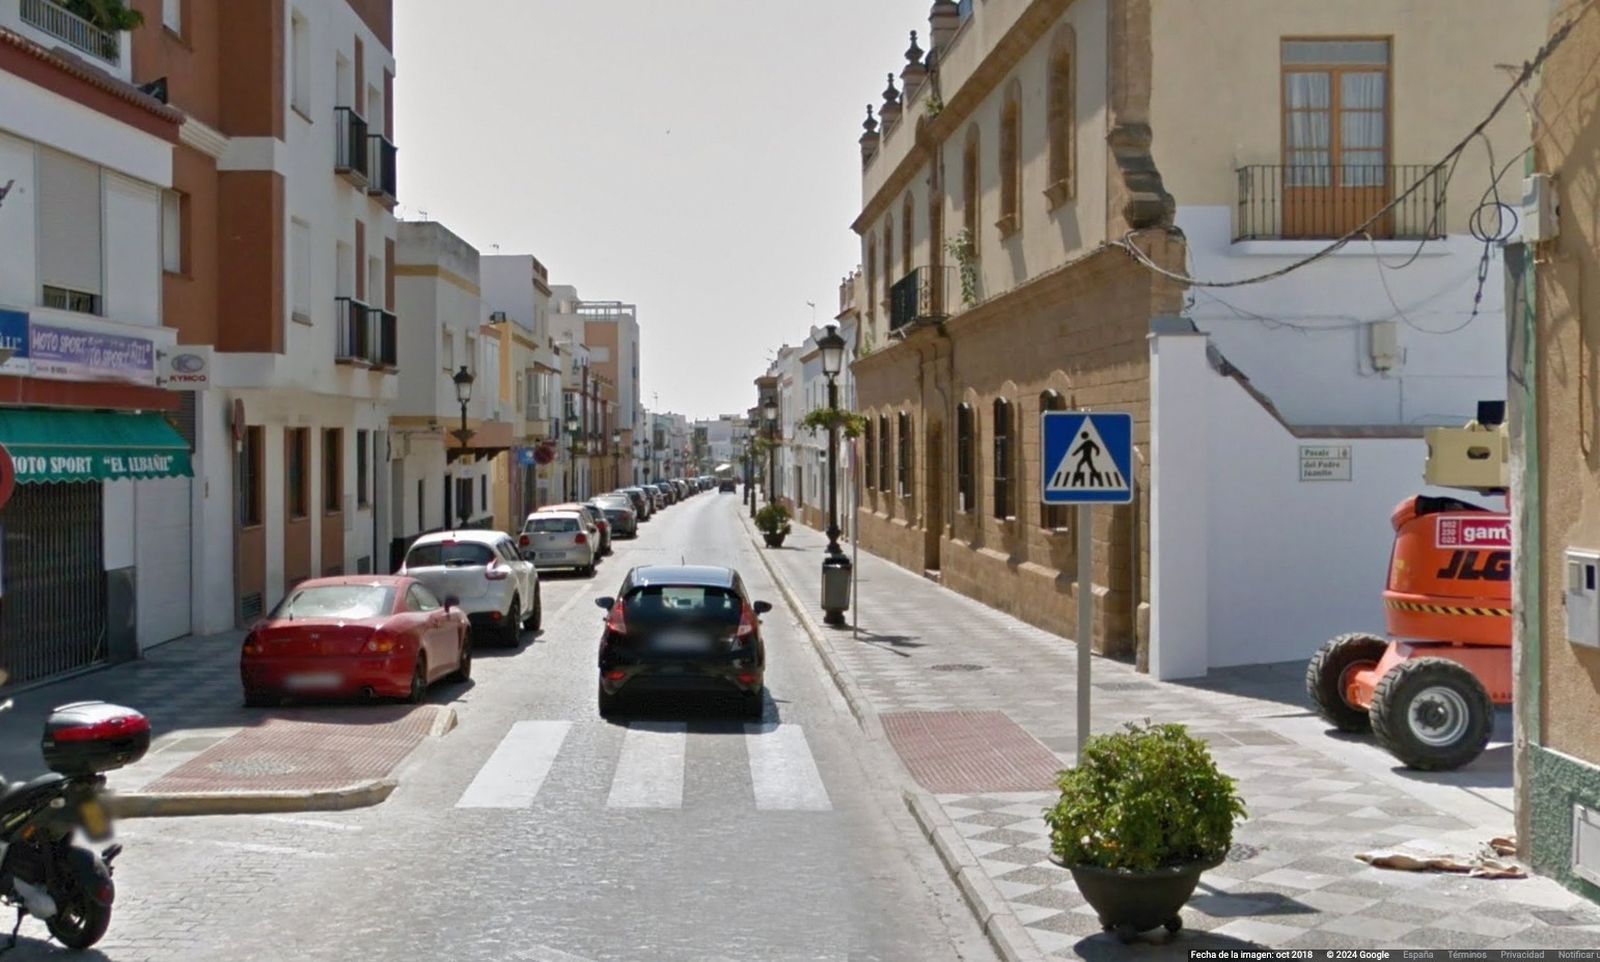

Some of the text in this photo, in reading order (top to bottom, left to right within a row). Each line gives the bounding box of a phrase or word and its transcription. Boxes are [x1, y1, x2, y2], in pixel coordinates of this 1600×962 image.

[169, 375, 207, 383] KYMCO
[49, 456, 93, 474] SPORT
[1463, 526, 1507, 542] gam
[1436, 551, 1512, 581] JLG
